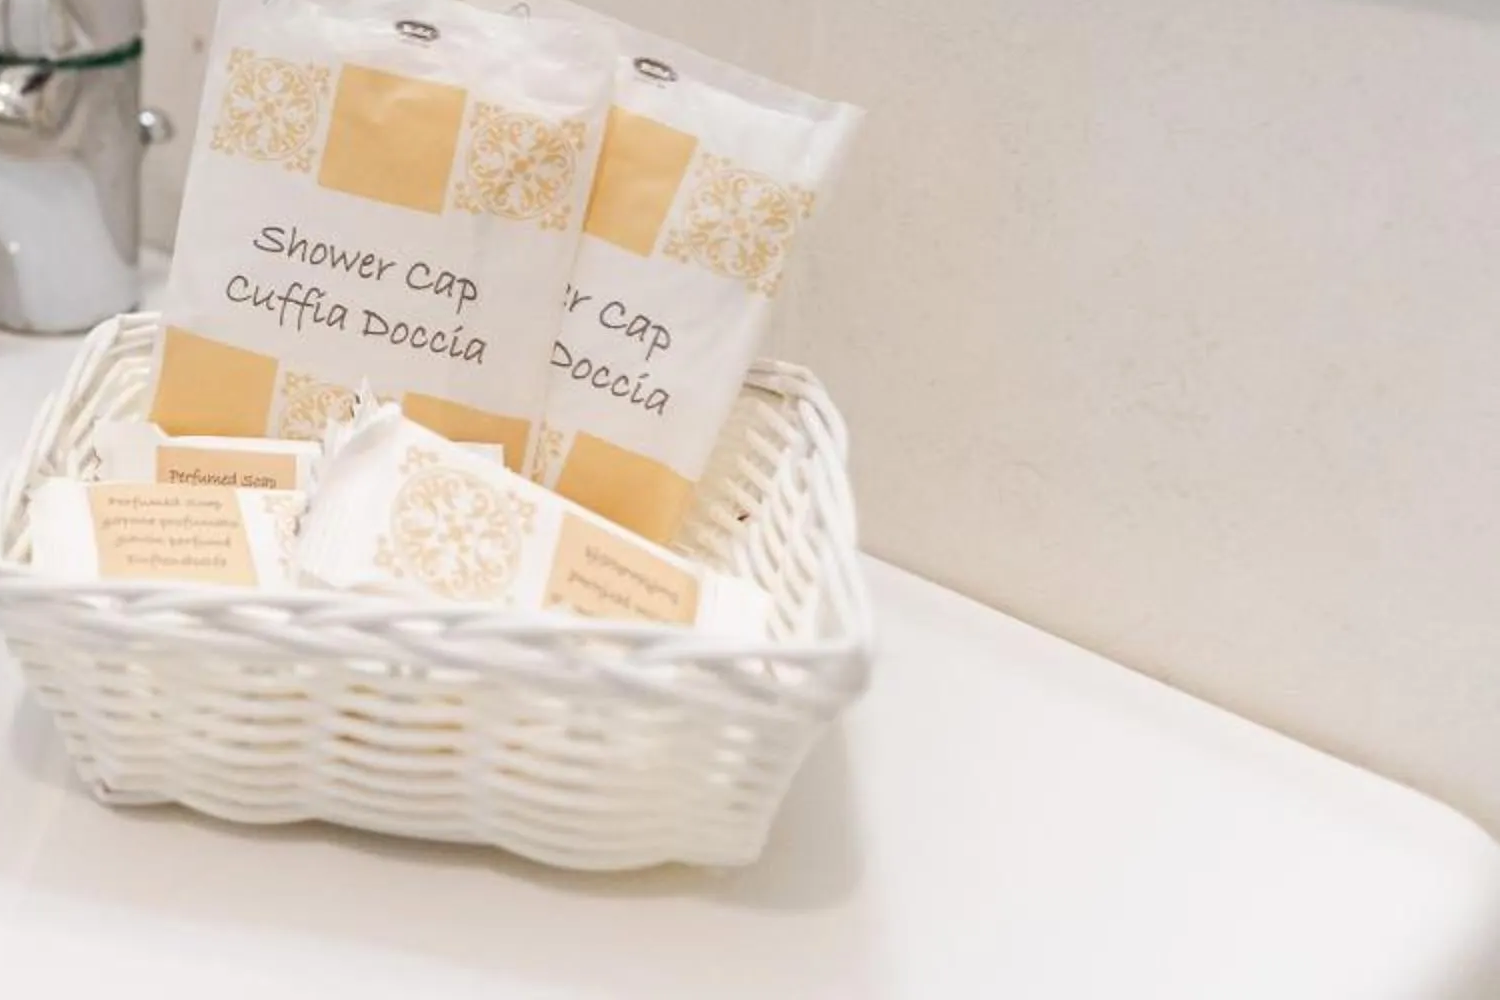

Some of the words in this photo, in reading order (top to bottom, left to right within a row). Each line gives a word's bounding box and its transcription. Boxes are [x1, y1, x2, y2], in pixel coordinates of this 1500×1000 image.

[252, 226, 396, 281] Shower
[405, 262, 478, 314] Cap
[225, 274, 346, 331] Cuffia
[362, 310, 488, 364] Doccia
[599, 301, 671, 361] Cap
[550, 340, 670, 416] Doccia
[168, 468, 237, 486] Perfumed
[240, 474, 277, 489] Soap
